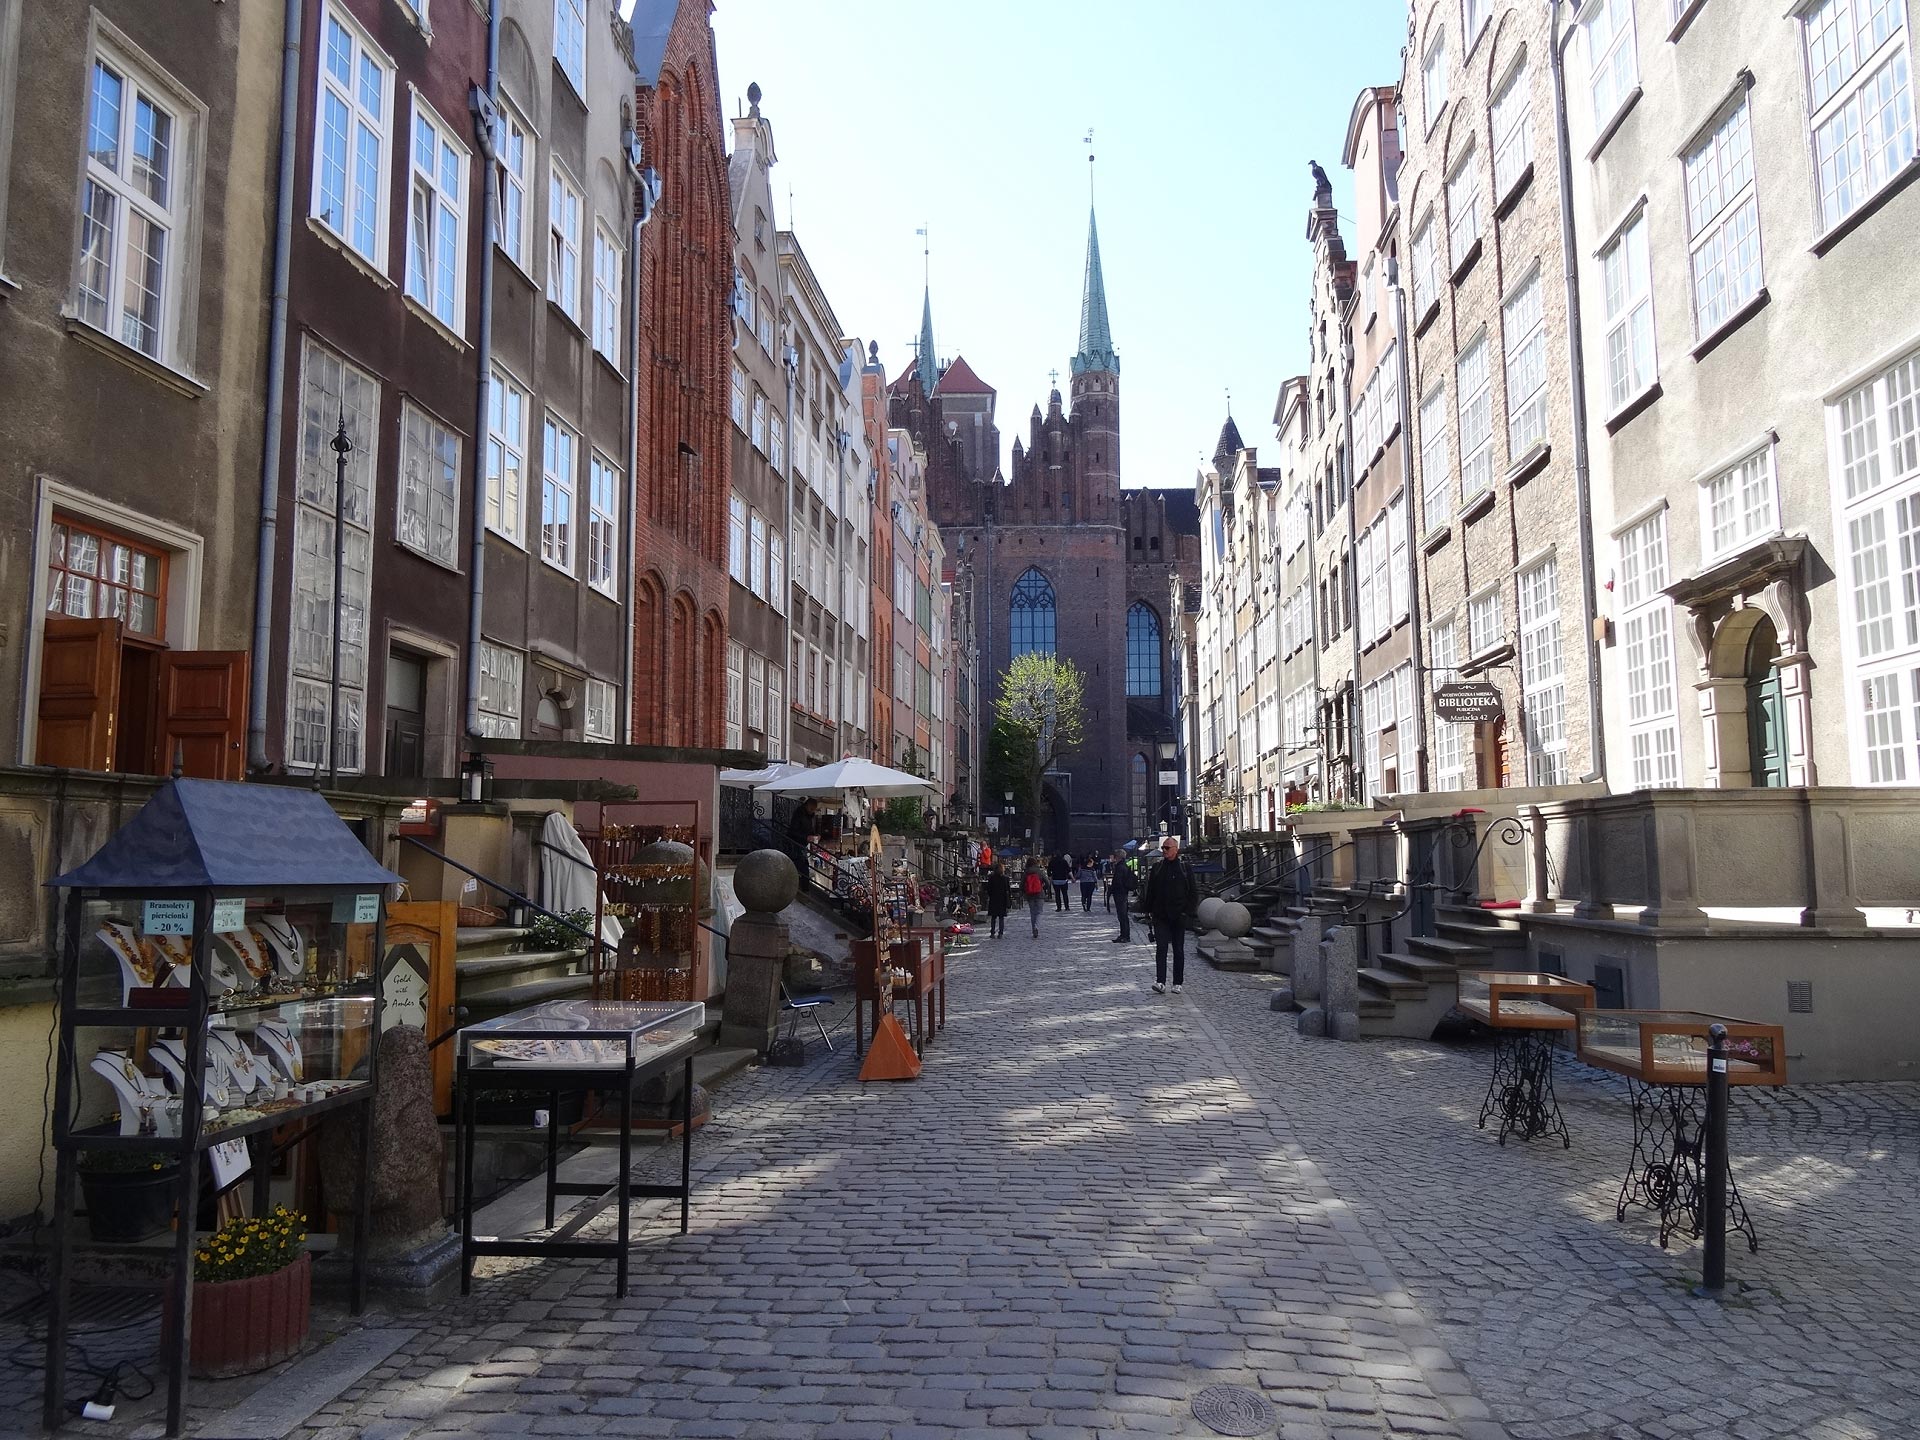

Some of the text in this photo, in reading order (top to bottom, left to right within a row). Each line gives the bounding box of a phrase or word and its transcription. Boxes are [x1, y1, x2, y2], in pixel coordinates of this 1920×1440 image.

[1438, 697, 1498, 707] BIBLIOTEKA
[150, 902, 185, 910] Bransolety
[151, 912, 188, 920] pierścionki
[160, 923, 171, 931] 20
[174, 923, 184, 932] %
[394, 975, 412, 984] Gold
[392, 998, 414, 1007] Amber
